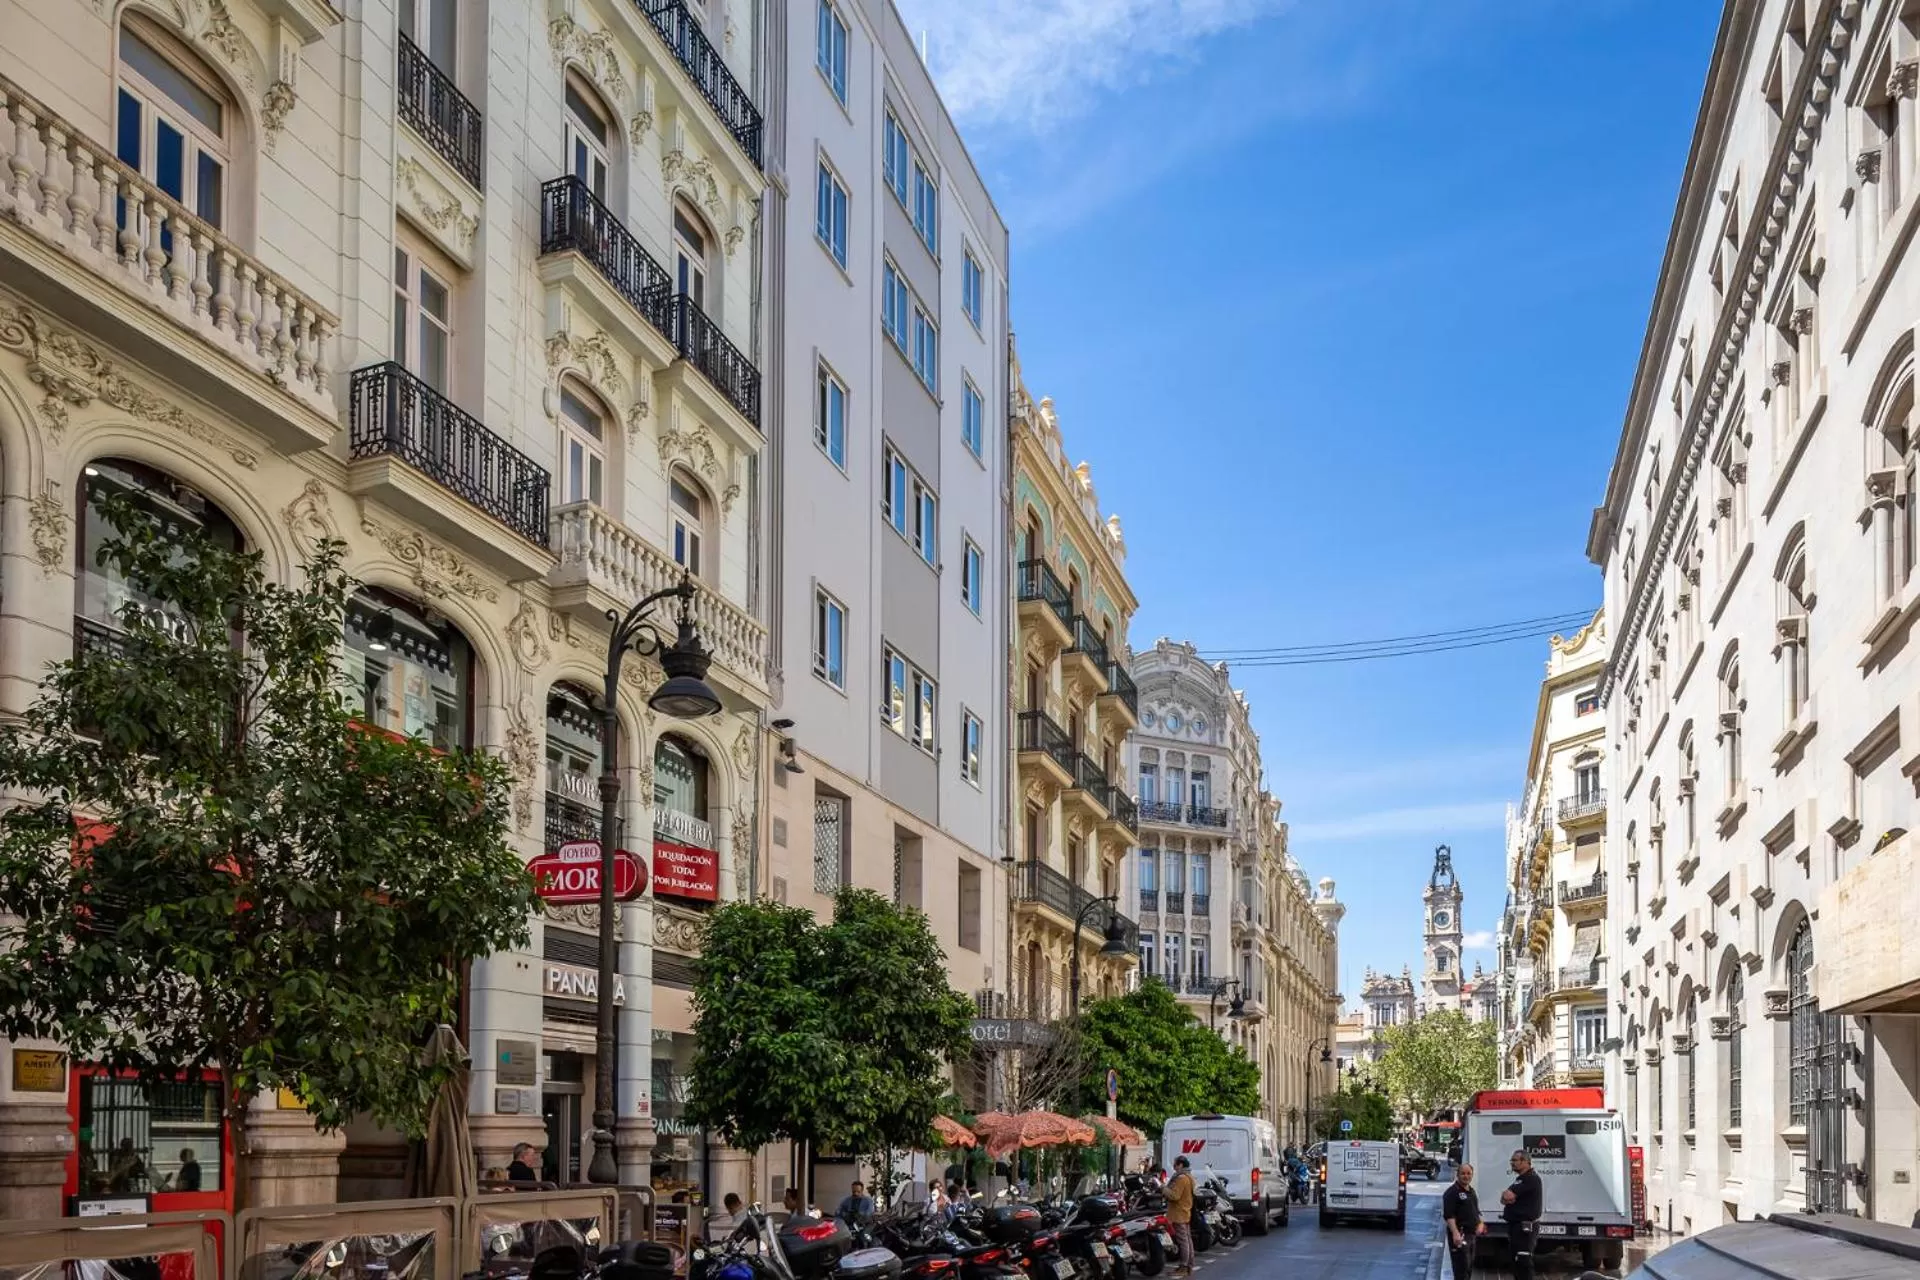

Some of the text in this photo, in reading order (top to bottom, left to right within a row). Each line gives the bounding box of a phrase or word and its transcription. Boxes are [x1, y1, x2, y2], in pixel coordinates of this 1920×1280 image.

[562, 773, 601, 801] MOR
[563, 846, 598, 861] JOYERO
[658, 849, 712, 866] LIQUIDACIÓN
[543, 867, 616, 892] MOR
[654, 875, 670, 885] POR
[671, 865, 697, 877] TOTAL
[549, 967, 626, 1002] PANAA
[968, 1022, 1010, 1041] otel
